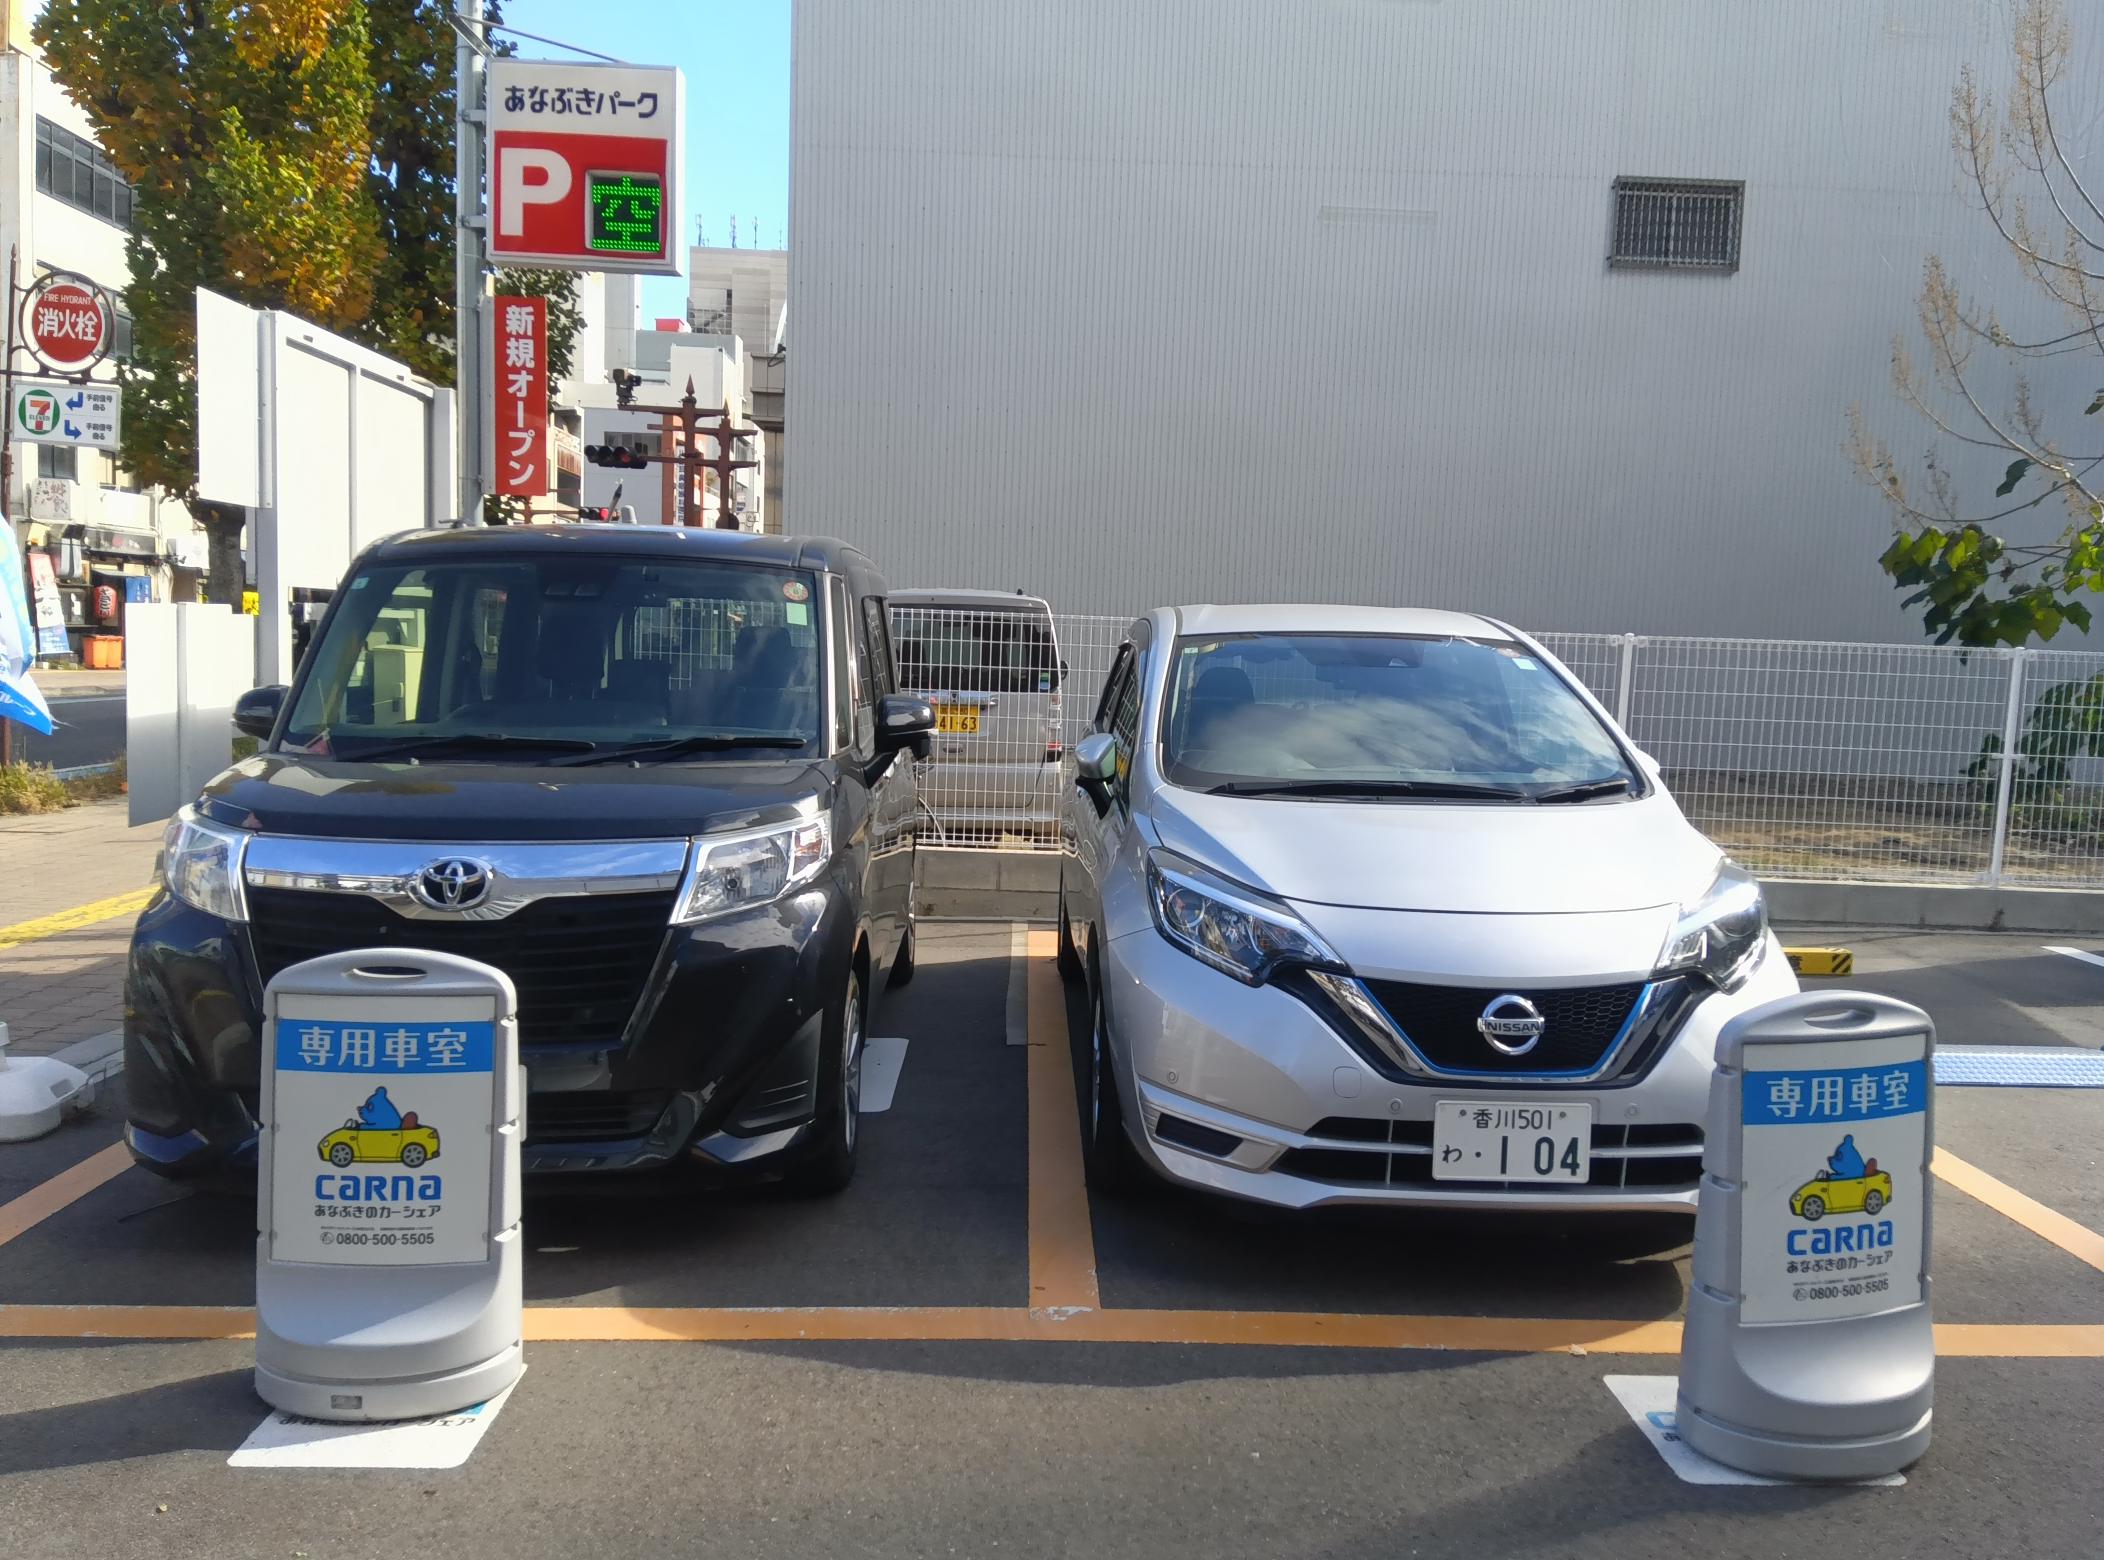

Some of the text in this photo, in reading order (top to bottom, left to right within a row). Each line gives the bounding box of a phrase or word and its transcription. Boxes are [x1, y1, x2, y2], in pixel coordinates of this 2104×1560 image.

[504, 85, 658, 118] あなぶきパーク
[500, 147, 573, 237] P
[592, 176, 660, 252] 空
[43, 293, 91, 304] FIRE HYDRANT
[38, 307, 97, 341] 消火栓
[505, 305, 535, 487] 新規オープン
[1487, 1021, 1540, 1033] NISSAN
[298, 1027, 467, 1067] 専用車室
[1766, 1070, 1911, 1118] 専用車室
[1472, 1108, 1552, 1130] 香川501
[314, 1204, 441, 1219] あなぶきのカーシェア
[336, 1232, 434, 1246] 0800-500-5505
[1786, 1249, 1893, 1274] あなぶきのカーシェア
[1809, 1277, 1889, 1300] 0800-500-5505
